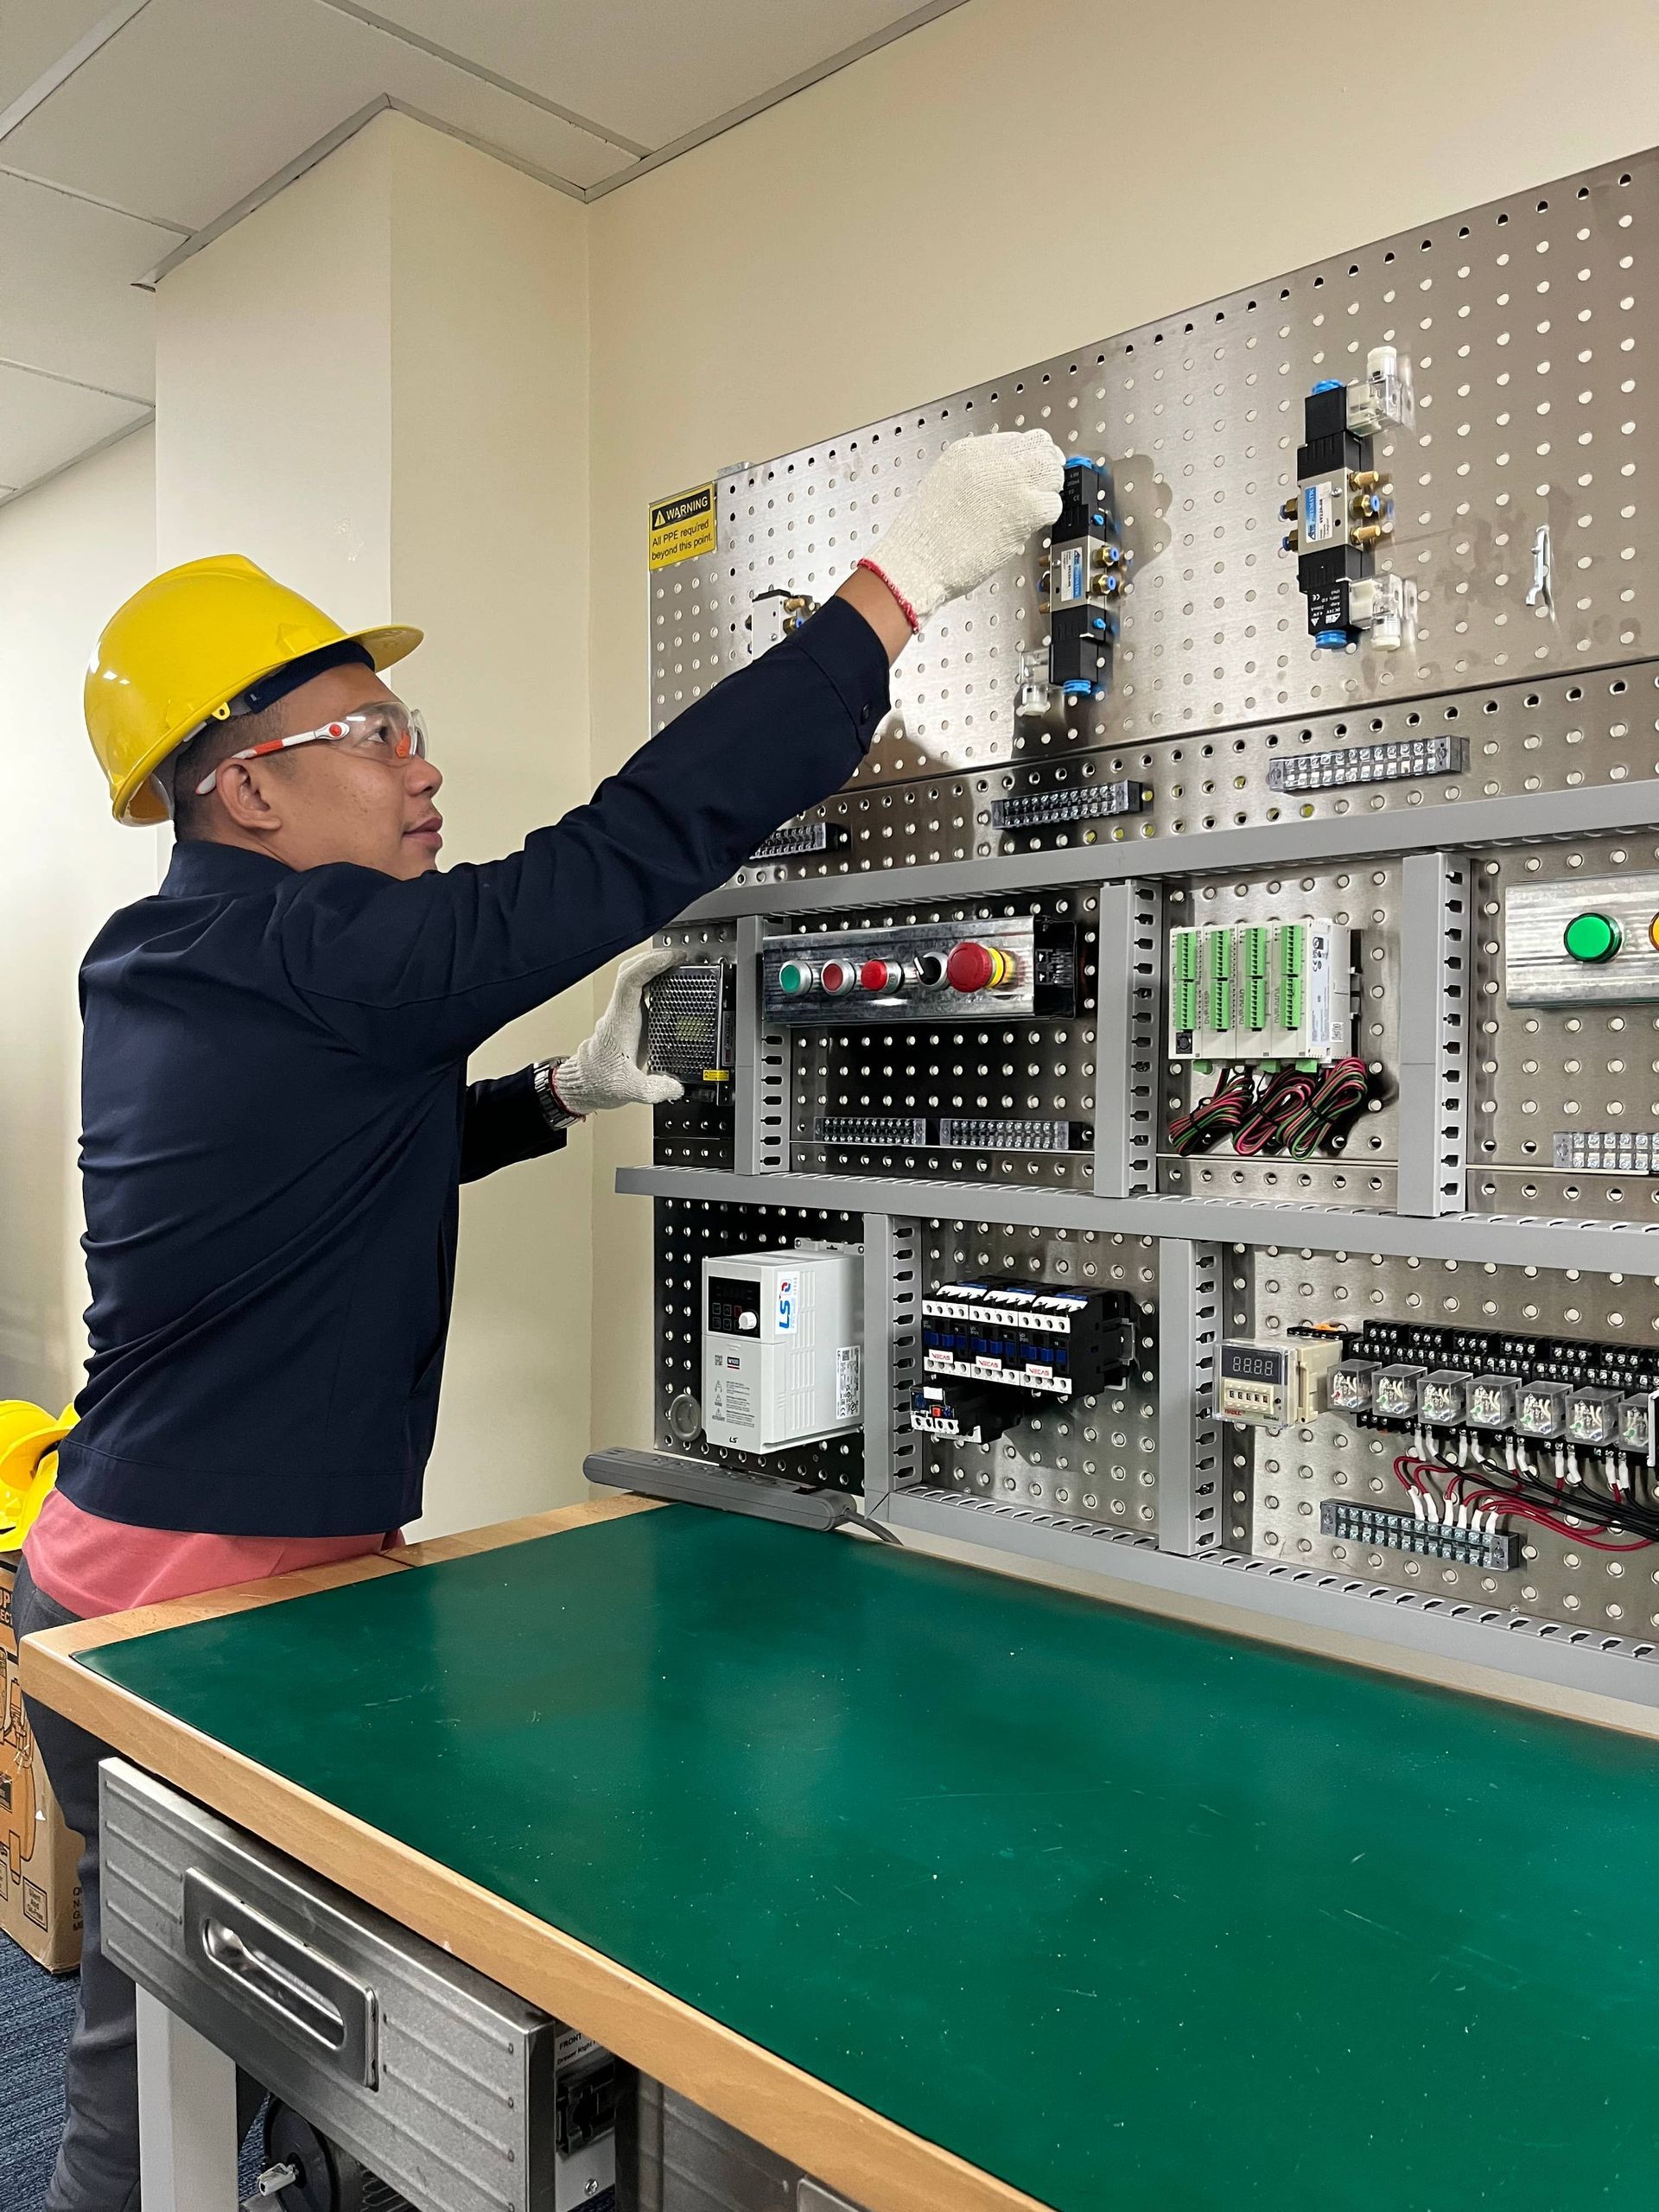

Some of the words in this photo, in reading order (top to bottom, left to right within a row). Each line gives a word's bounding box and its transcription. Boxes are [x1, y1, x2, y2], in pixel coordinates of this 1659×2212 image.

[666, 496, 708, 520] WARNING
[652, 537, 662, 547] All
[664, 531, 678, 543] PPE
[680, 518, 709, 537] required
[652, 544, 677, 561] beyond
[679, 540, 692, 551] this
[694, 534, 713, 548] point.
[779, 1300, 791, 1329] LS
[559, 2032, 582, 2050] FRONT
